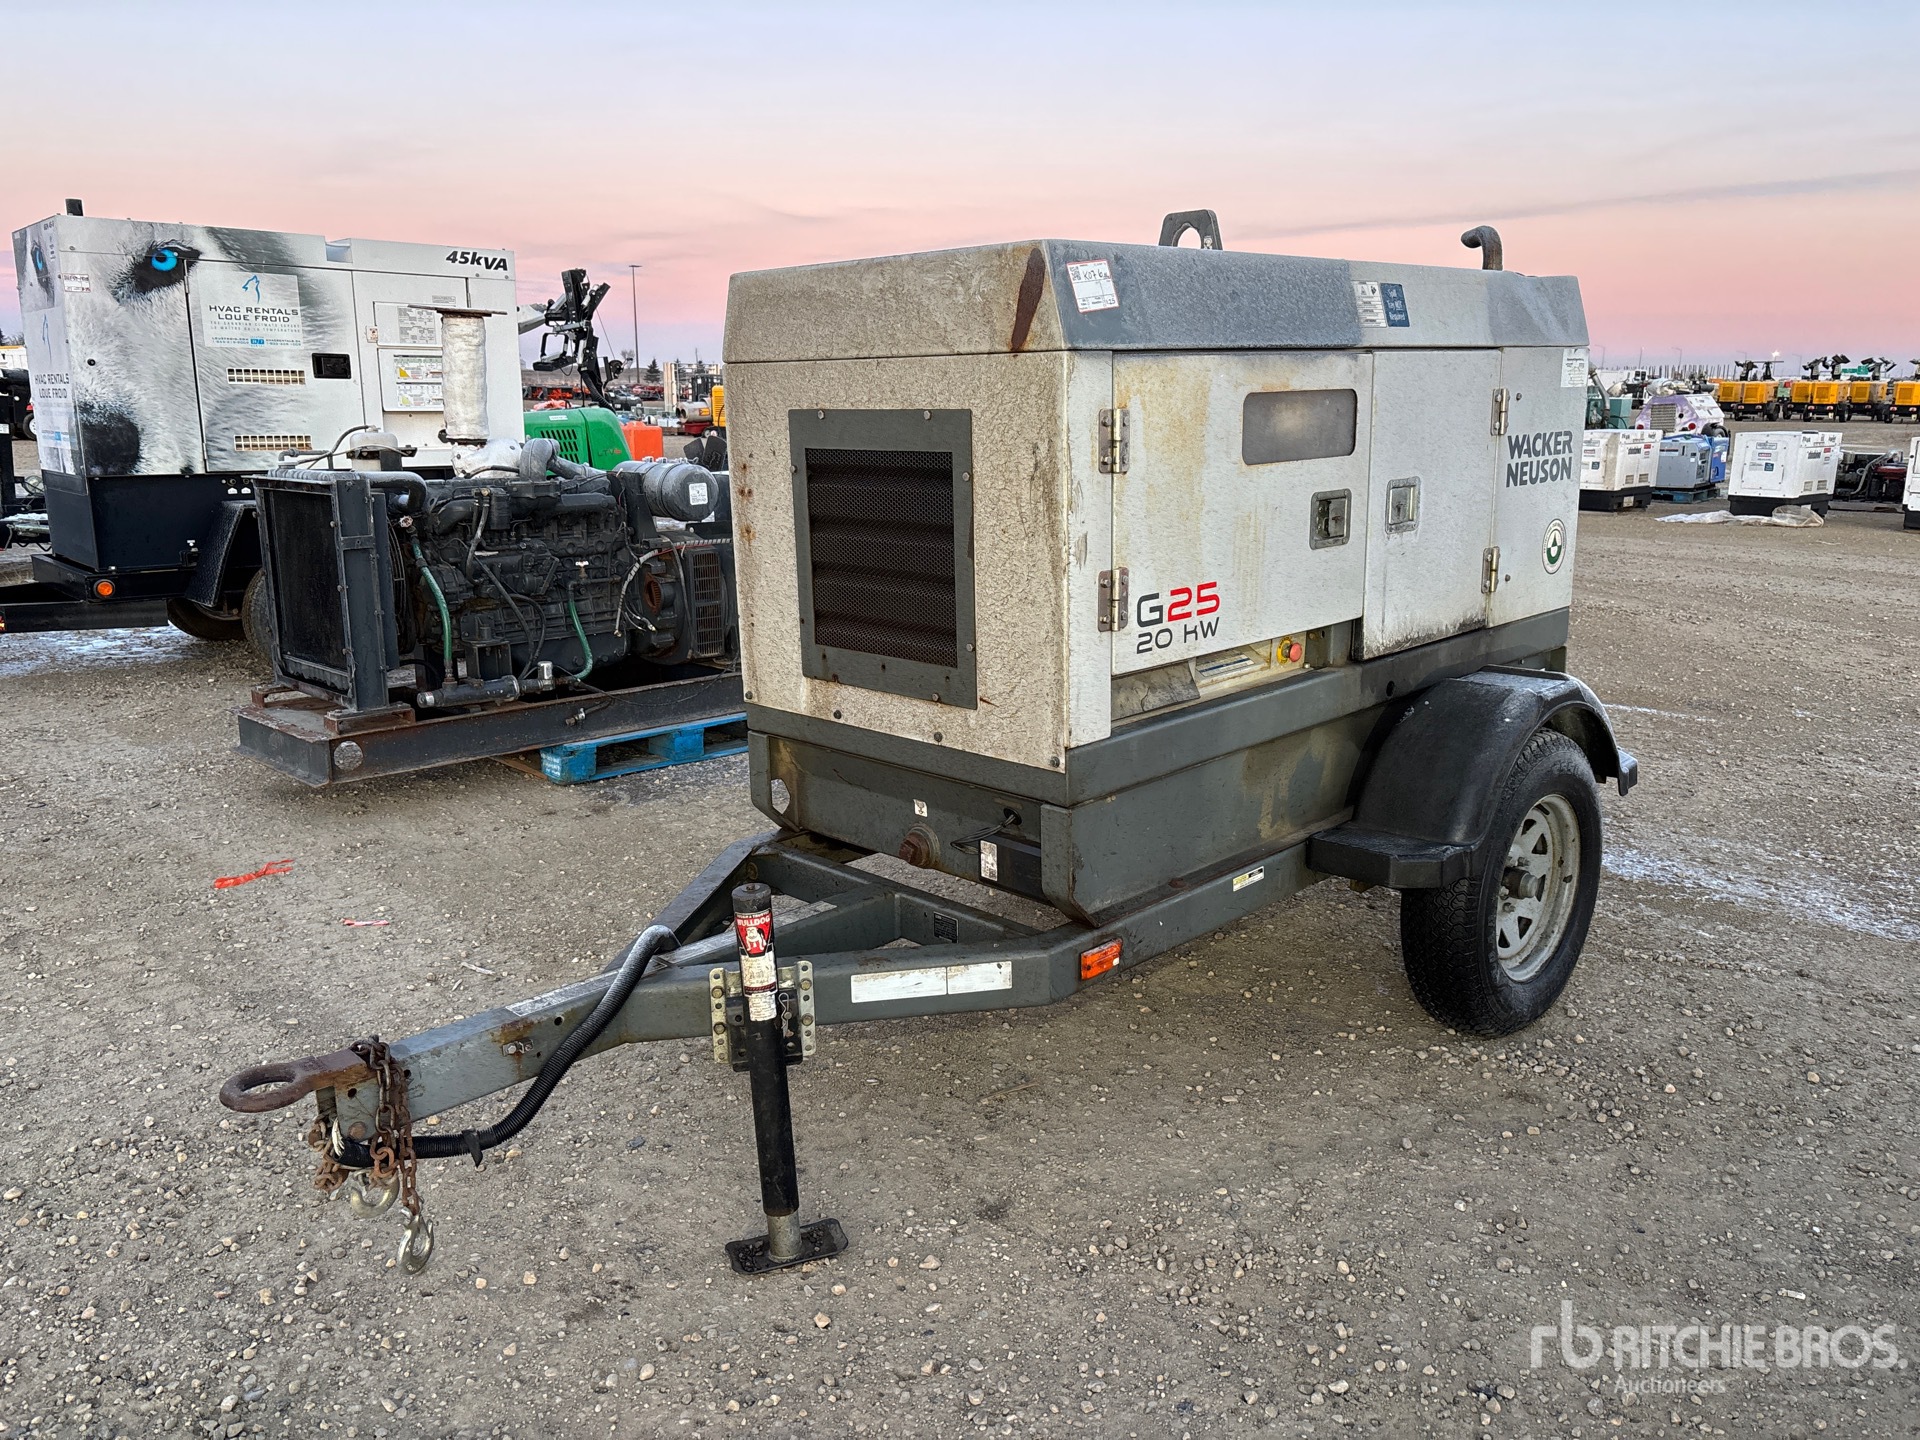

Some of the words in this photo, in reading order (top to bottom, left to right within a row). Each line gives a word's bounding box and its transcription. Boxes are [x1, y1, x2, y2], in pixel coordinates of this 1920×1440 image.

[445, 250, 508, 271] 45kVA
[209, 305, 241, 313] HVAC
[245, 306, 299, 316] RENTALS
[217, 313, 250, 321] LOUE
[254, 315, 290, 323] FROID
[47, 373, 69, 384] RENTALS
[1507, 430, 1573, 460] WACKER
[1505, 456, 1573, 488] NEUSON
[1136, 581, 1220, 628] G25
[1136, 627, 1173, 655] 20
[737, 916, 770, 926] BULLDOG
